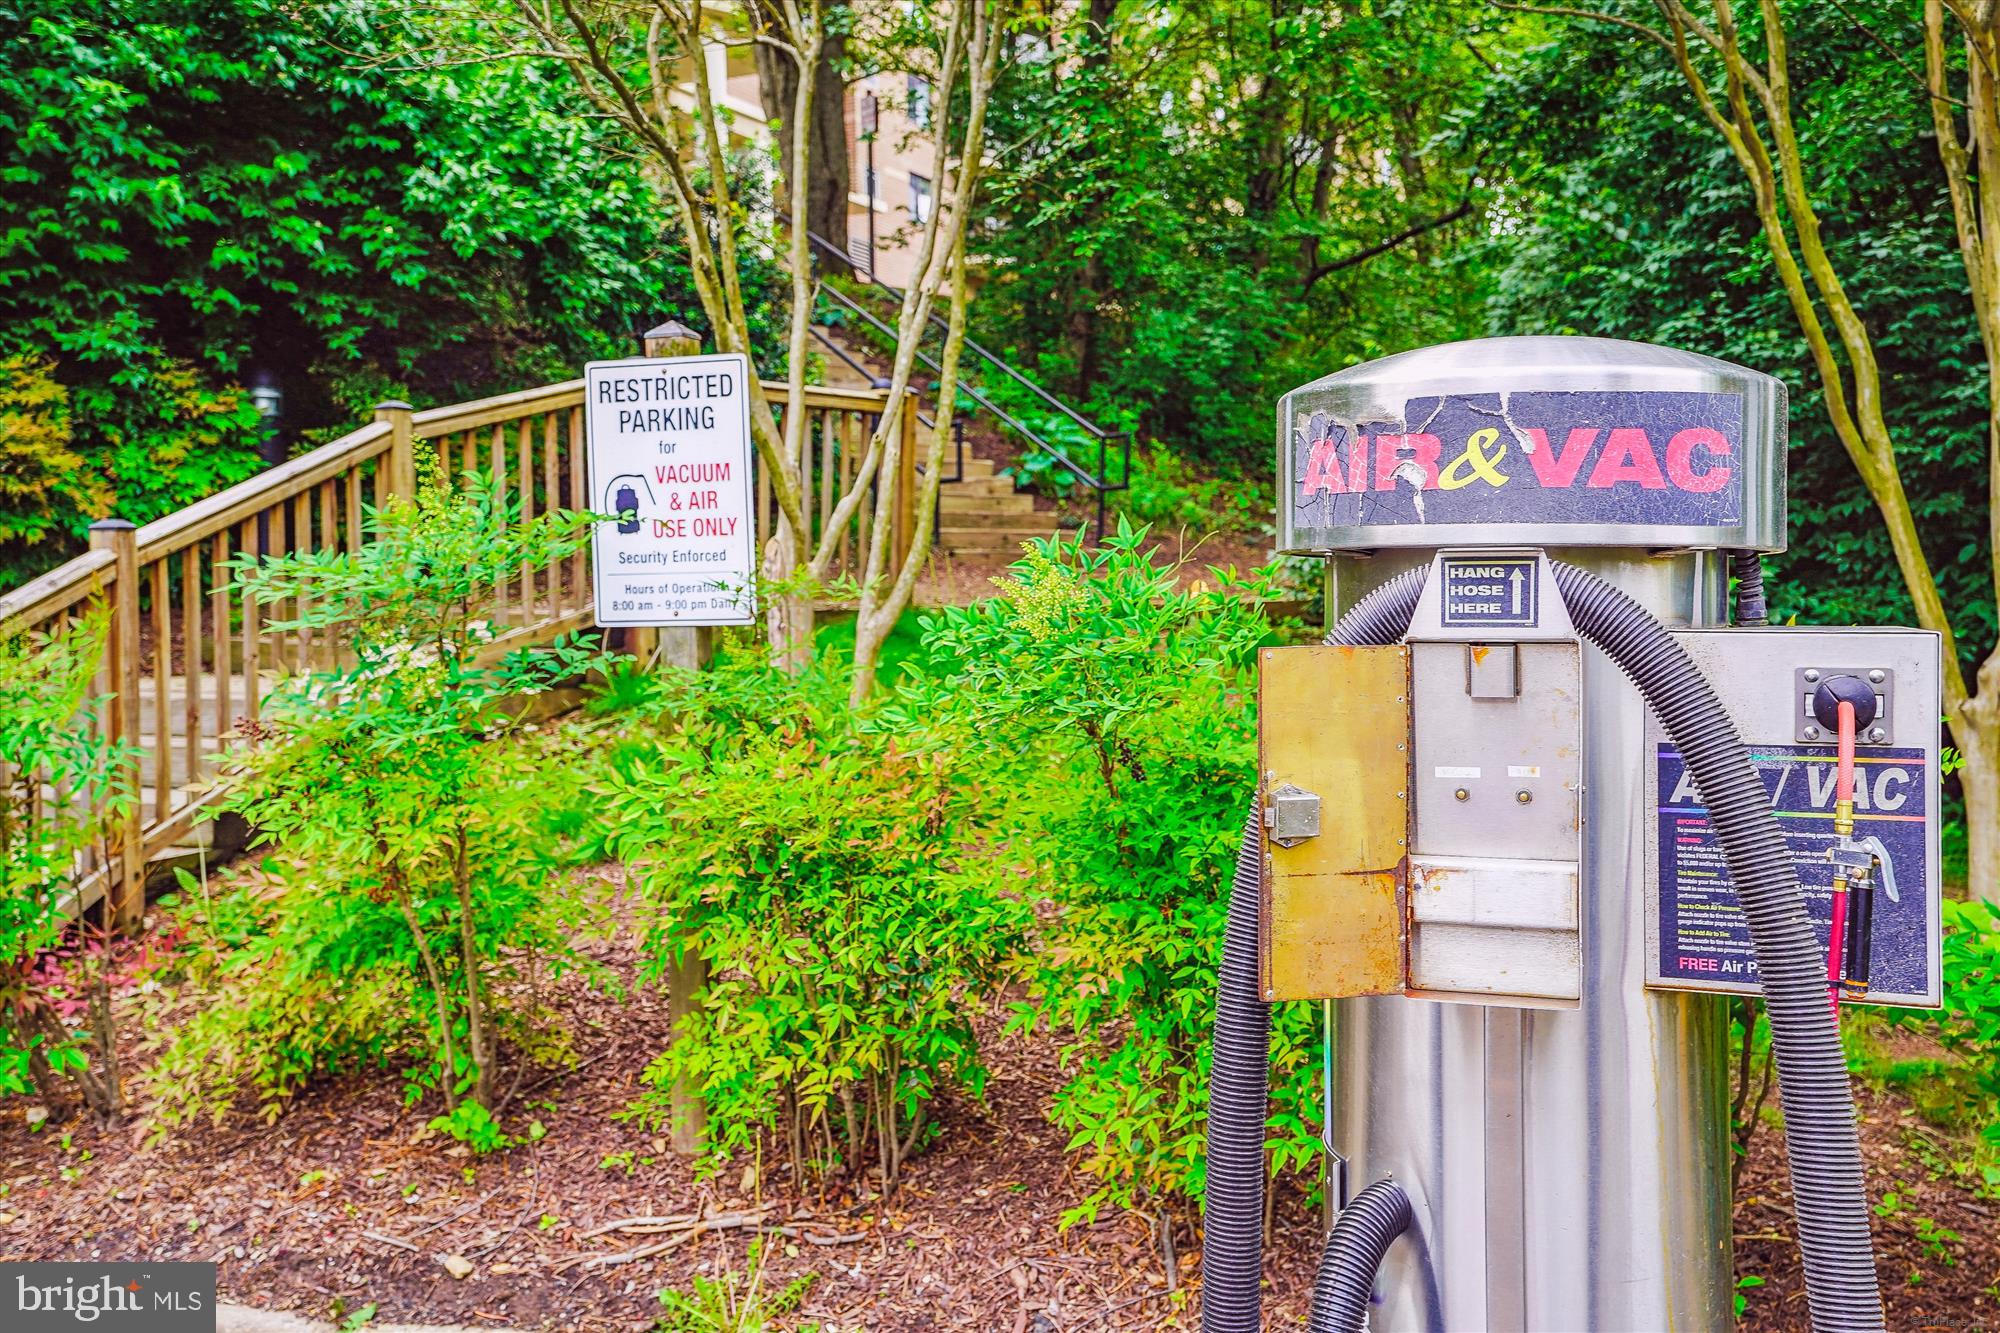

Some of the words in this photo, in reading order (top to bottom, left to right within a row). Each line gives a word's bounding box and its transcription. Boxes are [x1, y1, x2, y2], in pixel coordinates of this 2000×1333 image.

[599, 374, 733, 404] RESTRICTED
[620, 406, 714, 433] PARKING
[659, 440, 676, 454] for
[1302, 431, 1442, 495] AIR
[1436, 427, 1510, 490] &
[1526, 427, 1732, 494] VAC
[656, 463, 730, 484] VACUUM
[670, 492, 682, 510] &
[688, 490, 718, 510] AIR
[653, 519, 686, 538] USE
[694, 517, 738, 536] ONLY
[619, 551, 668, 565] Security
[672, 550, 726, 562] Enforced
[1450, 567, 1504, 578] HANG
[624, 584, 654, 594] Hours
[658, 584, 668, 593] of
[672, 584, 728, 596] Operatio
[1450, 584, 1504, 596] HOSE
[612, 600, 634, 611] 8:00
[638, 602, 653, 610] am
[666, 600, 688, 610] 9:00
[691, 602, 707, 611] pm
[1450, 603, 1502, 614] HERE
[1807, 766, 1910, 811] VAC
[1680, 957, 1718, 971] FREE
[1721, 960, 1743, 973] Air
